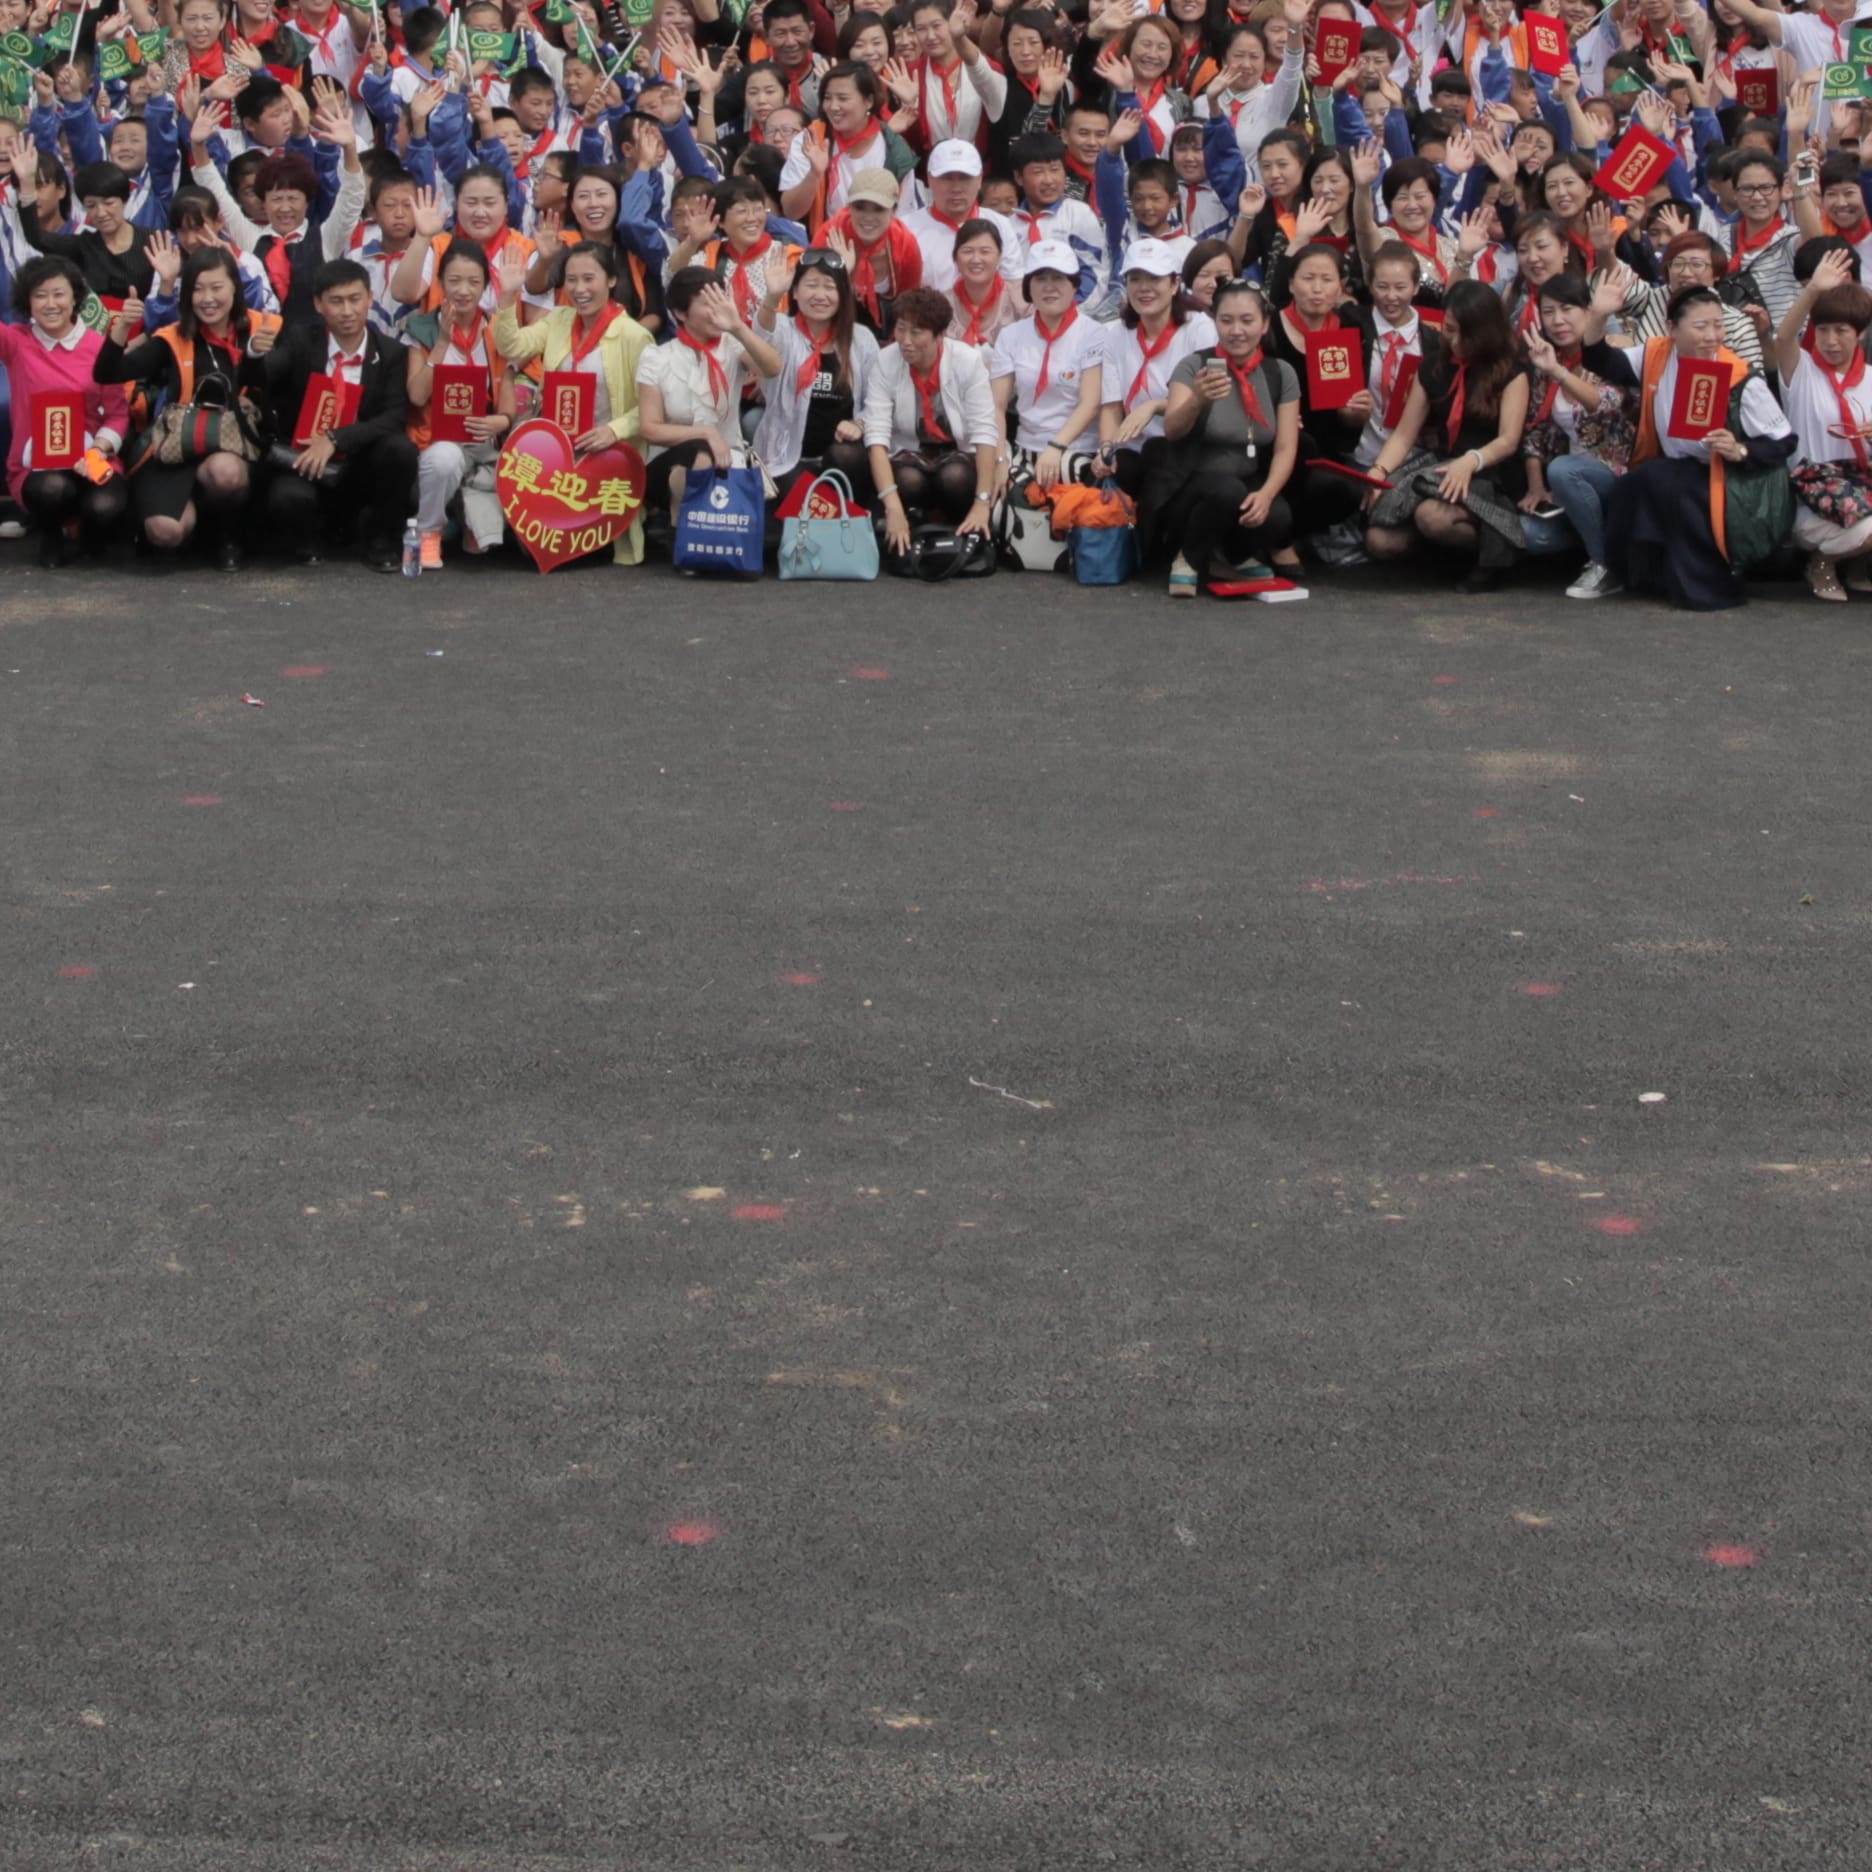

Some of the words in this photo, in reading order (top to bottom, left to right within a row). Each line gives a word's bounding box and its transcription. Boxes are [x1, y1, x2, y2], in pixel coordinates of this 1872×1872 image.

[499, 449, 641, 516] 谭迎春
[504, 494, 520, 520] I
[516, 519, 563, 554] LOVE
[570, 522, 613, 553] YOU
